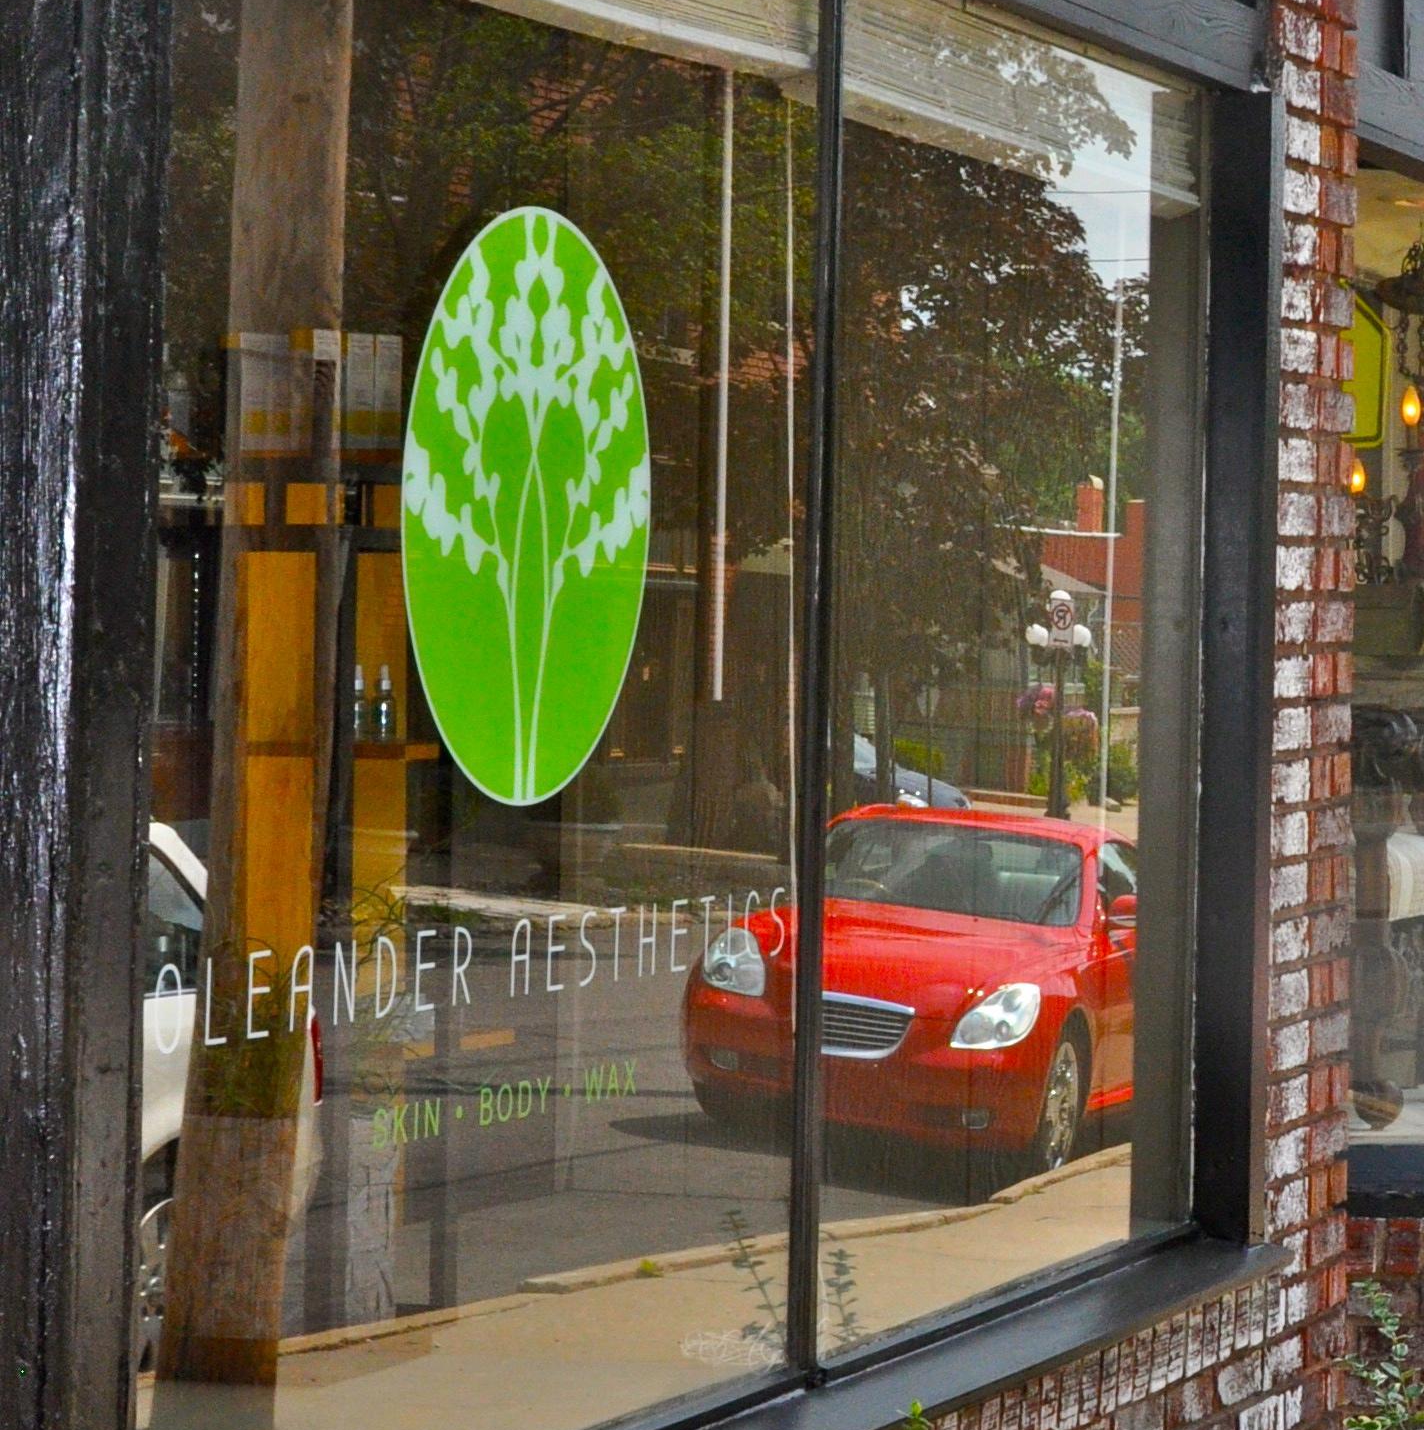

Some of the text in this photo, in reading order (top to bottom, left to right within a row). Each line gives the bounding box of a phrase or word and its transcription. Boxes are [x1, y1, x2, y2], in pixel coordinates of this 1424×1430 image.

[154, 886, 787, 1055] OLEANDER AESTHETICS
[372, 1062, 638, 1150] SKIN BODY WAX
